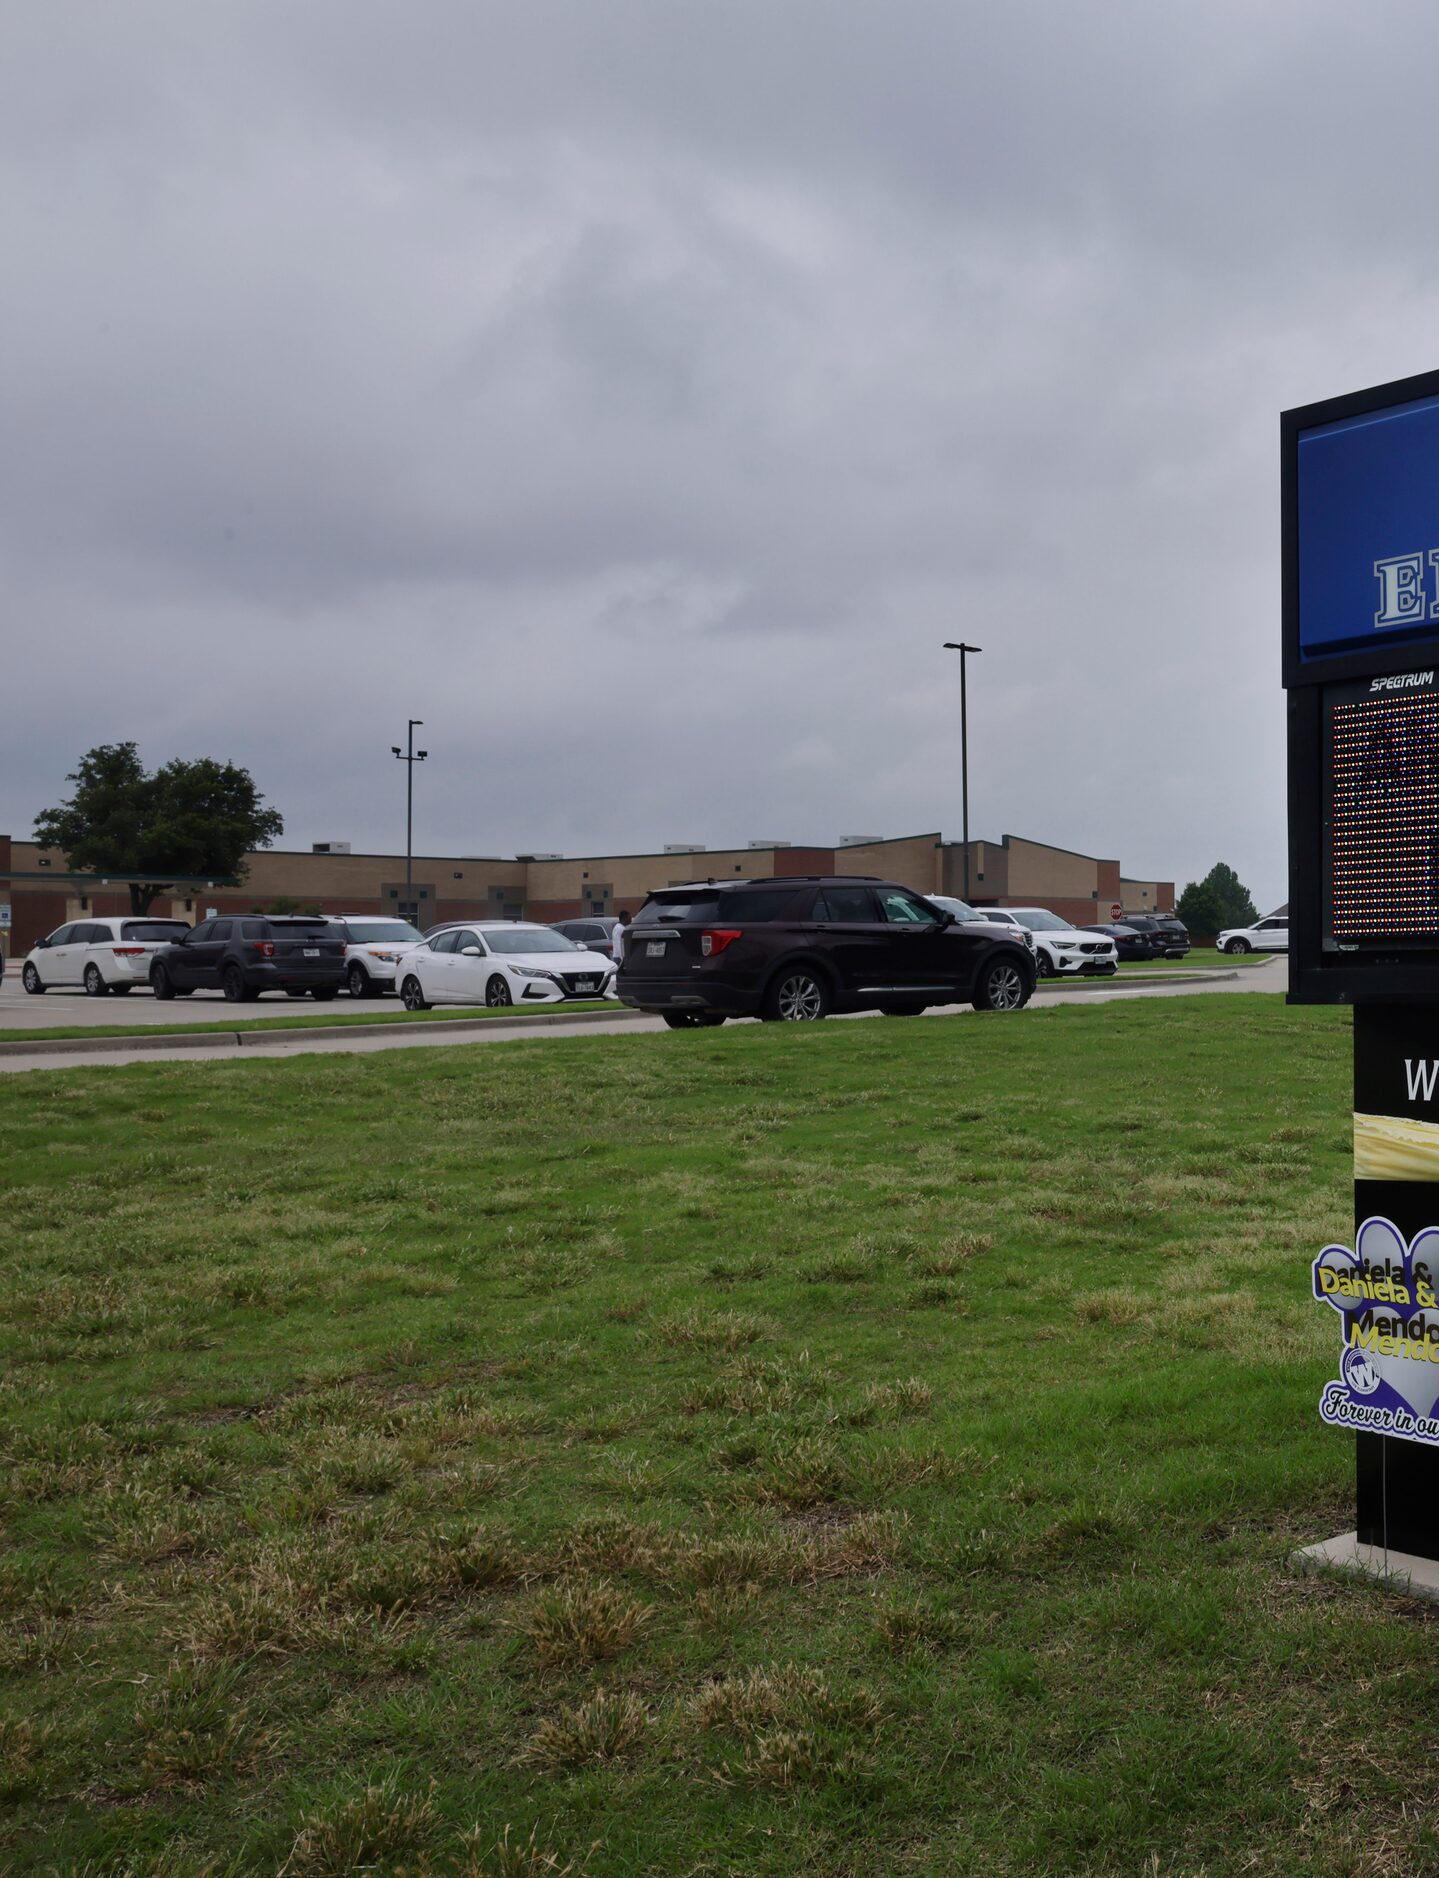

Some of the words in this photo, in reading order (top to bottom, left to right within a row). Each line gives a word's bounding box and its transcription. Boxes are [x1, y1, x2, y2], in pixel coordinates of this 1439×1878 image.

[1369, 671, 1434, 692] SPECTRUM
[1318, 1267, 1411, 1305] Daniela
[1416, 1281, 1439, 1309] &
[1326, 1390, 1391, 1427] Forever
[1395, 1409, 1413, 1431] in
